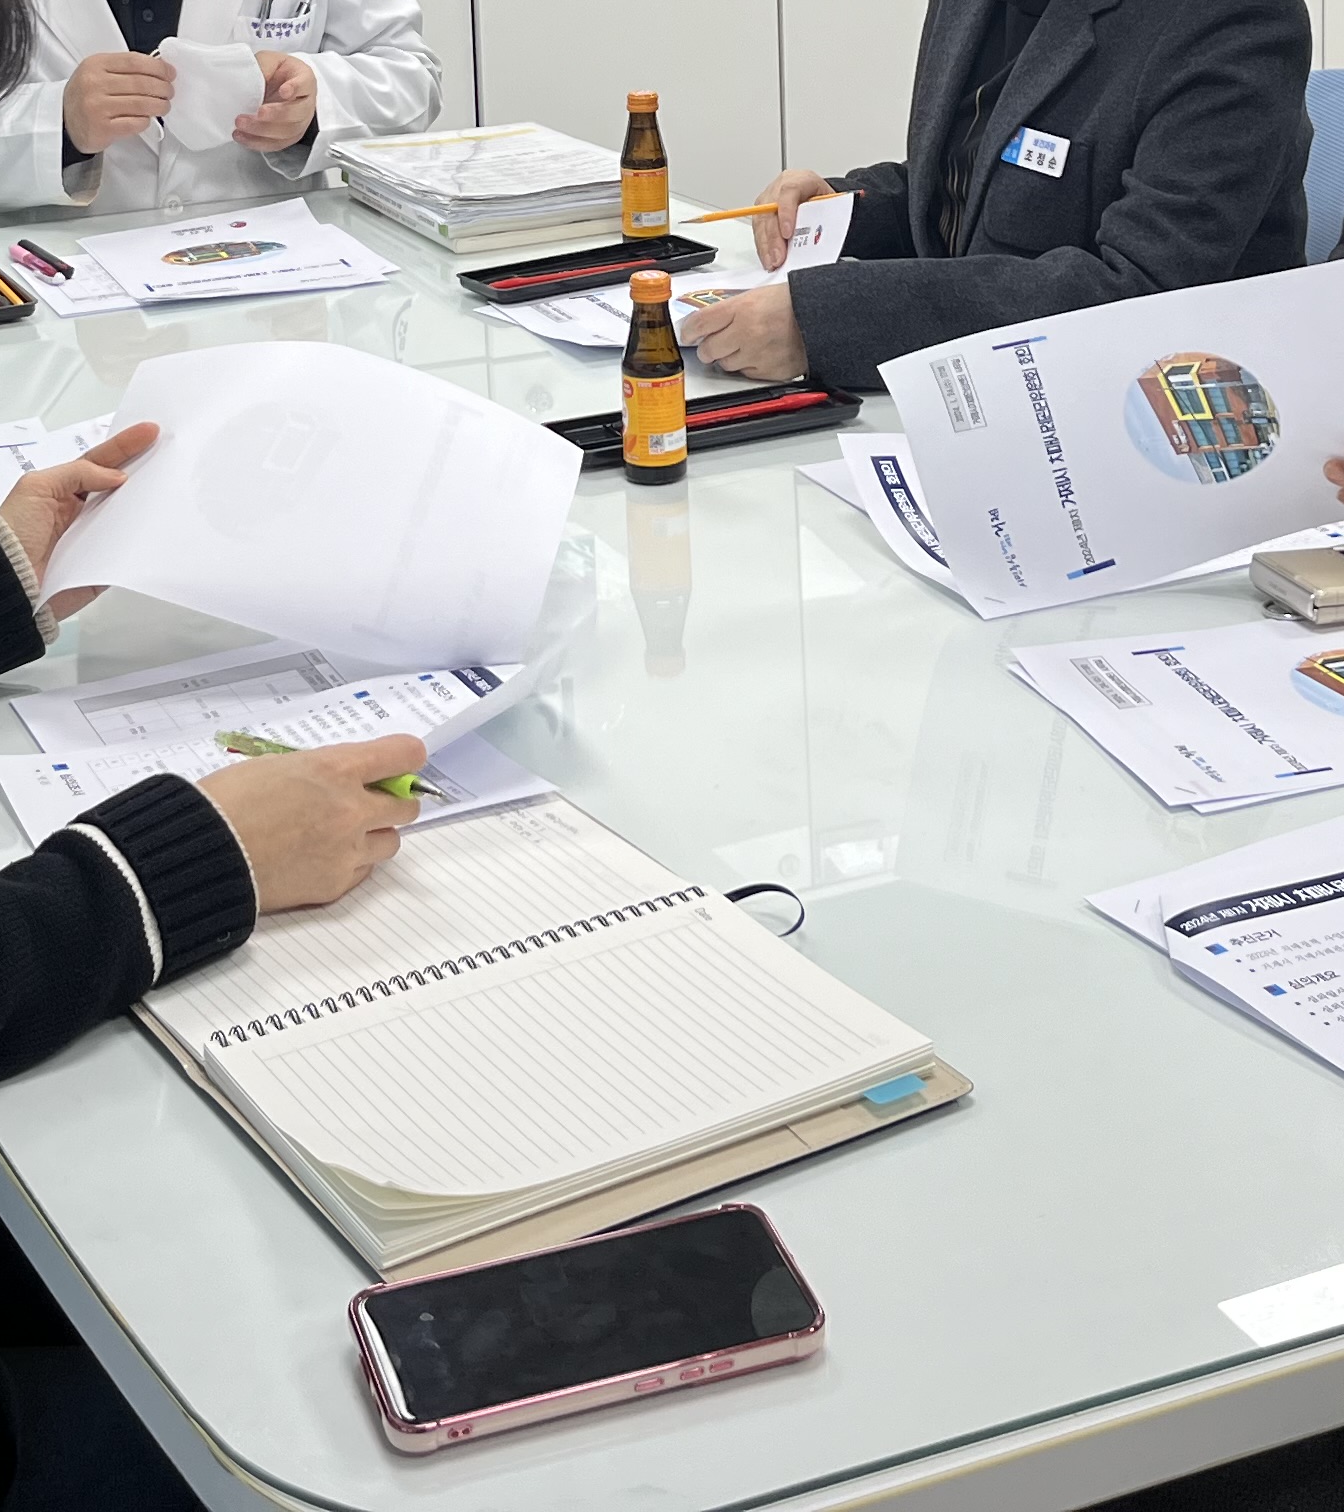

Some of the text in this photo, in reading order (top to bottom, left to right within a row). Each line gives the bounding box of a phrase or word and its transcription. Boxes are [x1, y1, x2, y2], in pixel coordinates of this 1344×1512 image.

[1010, 342, 1034, 365] 회의
[1022, 368, 1064, 464] 치매사례관리위원회
[1052, 468, 1076, 508] 거제시
[1076, 534, 1095, 565] 2024년
[1179, 913, 1217, 932] 2024년
[1241, 893, 1296, 915] 거제시
[1230, 929, 1282, 946] 추진근거
[1288, 971, 1340, 989] 심의개요
